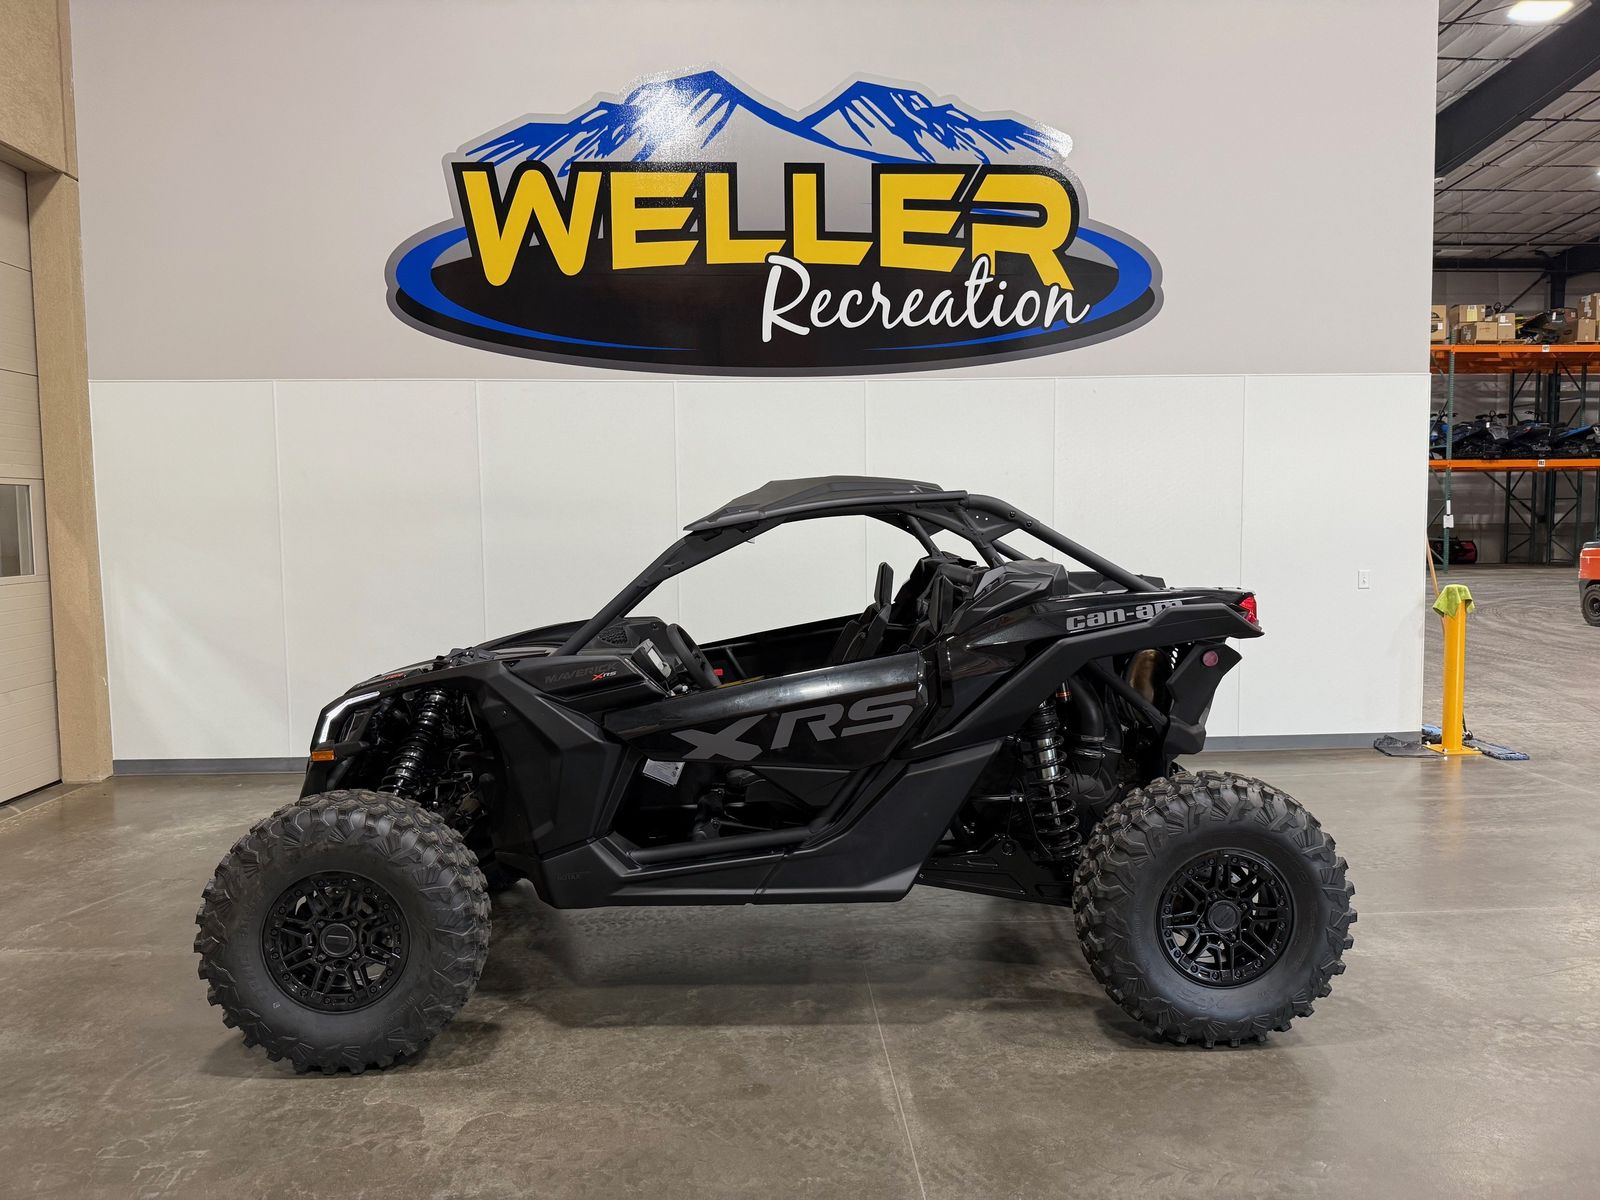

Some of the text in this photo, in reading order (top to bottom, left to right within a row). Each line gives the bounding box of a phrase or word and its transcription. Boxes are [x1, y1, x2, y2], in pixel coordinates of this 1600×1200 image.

[463, 169, 1073, 289] WELLER
[762, 255, 1091, 343] Recreation
[671, 690, 917, 762] XRS
